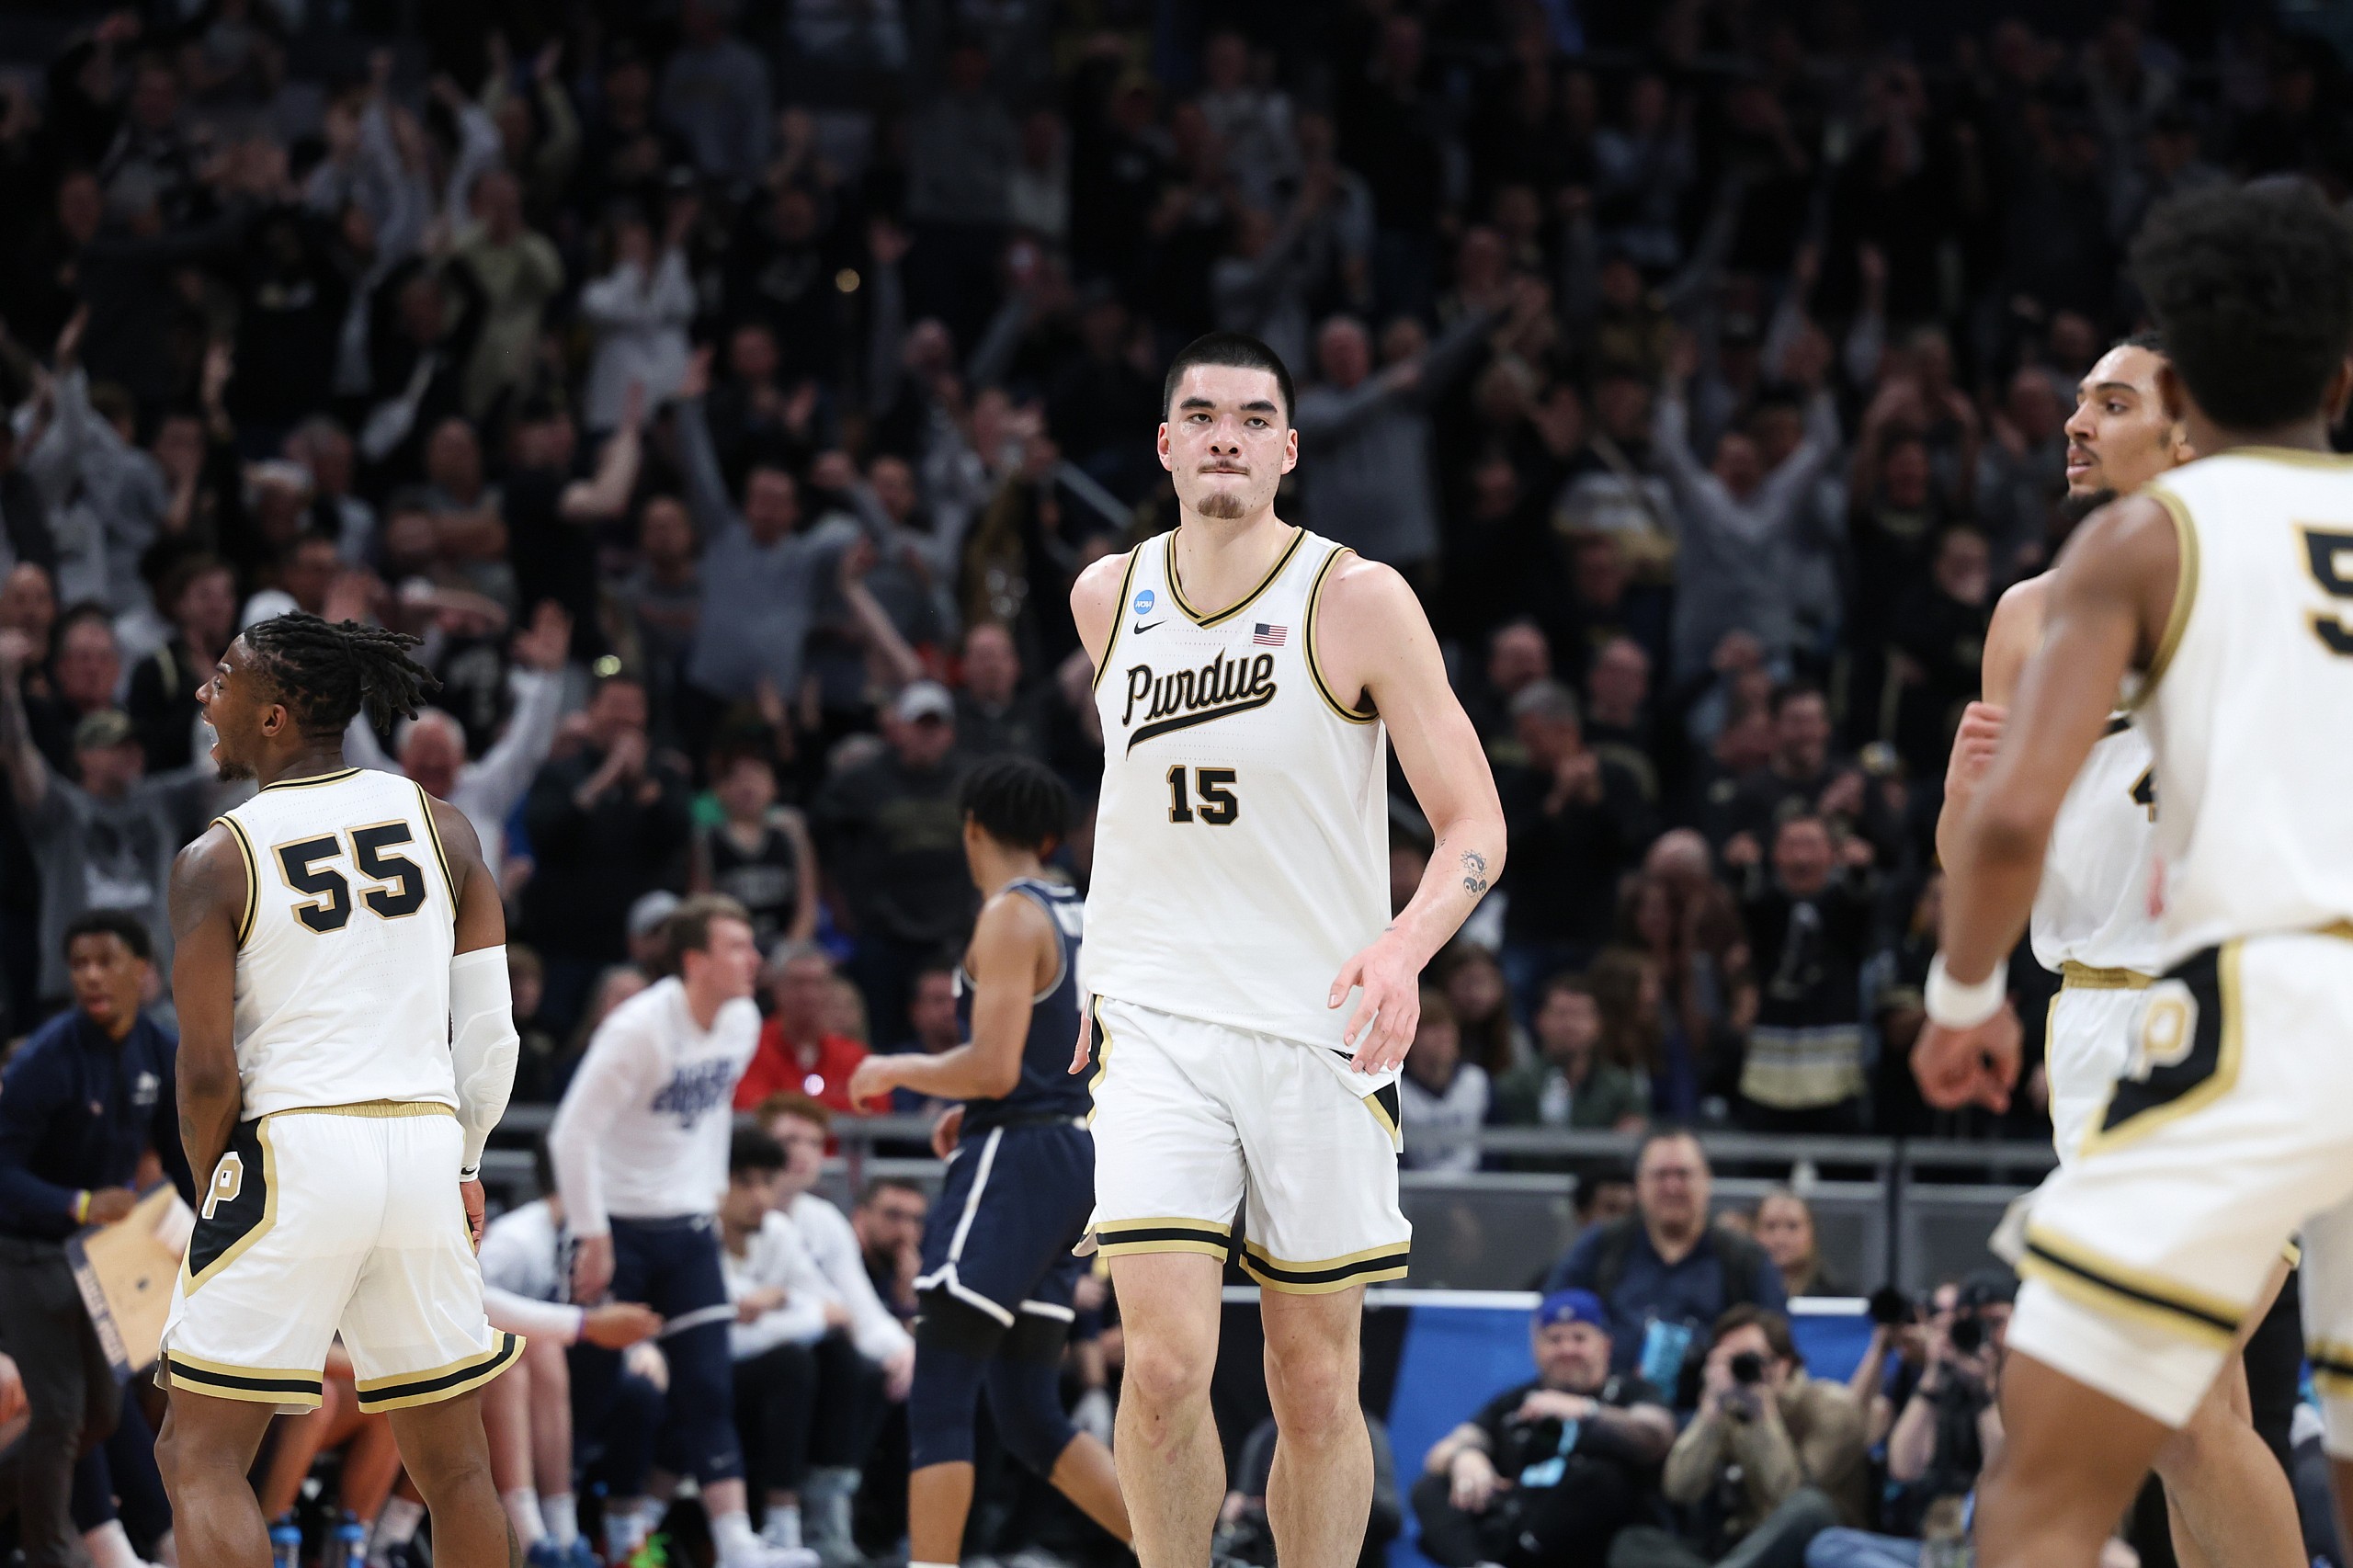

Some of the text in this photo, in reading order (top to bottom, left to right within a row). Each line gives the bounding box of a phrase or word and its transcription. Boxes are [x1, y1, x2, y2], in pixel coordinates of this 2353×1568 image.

[1122, 647, 1278, 726] Purdue
[1166, 765, 1239, 825] 15
[270, 819, 428, 935] 55
[201, 1151, 244, 1220] P
